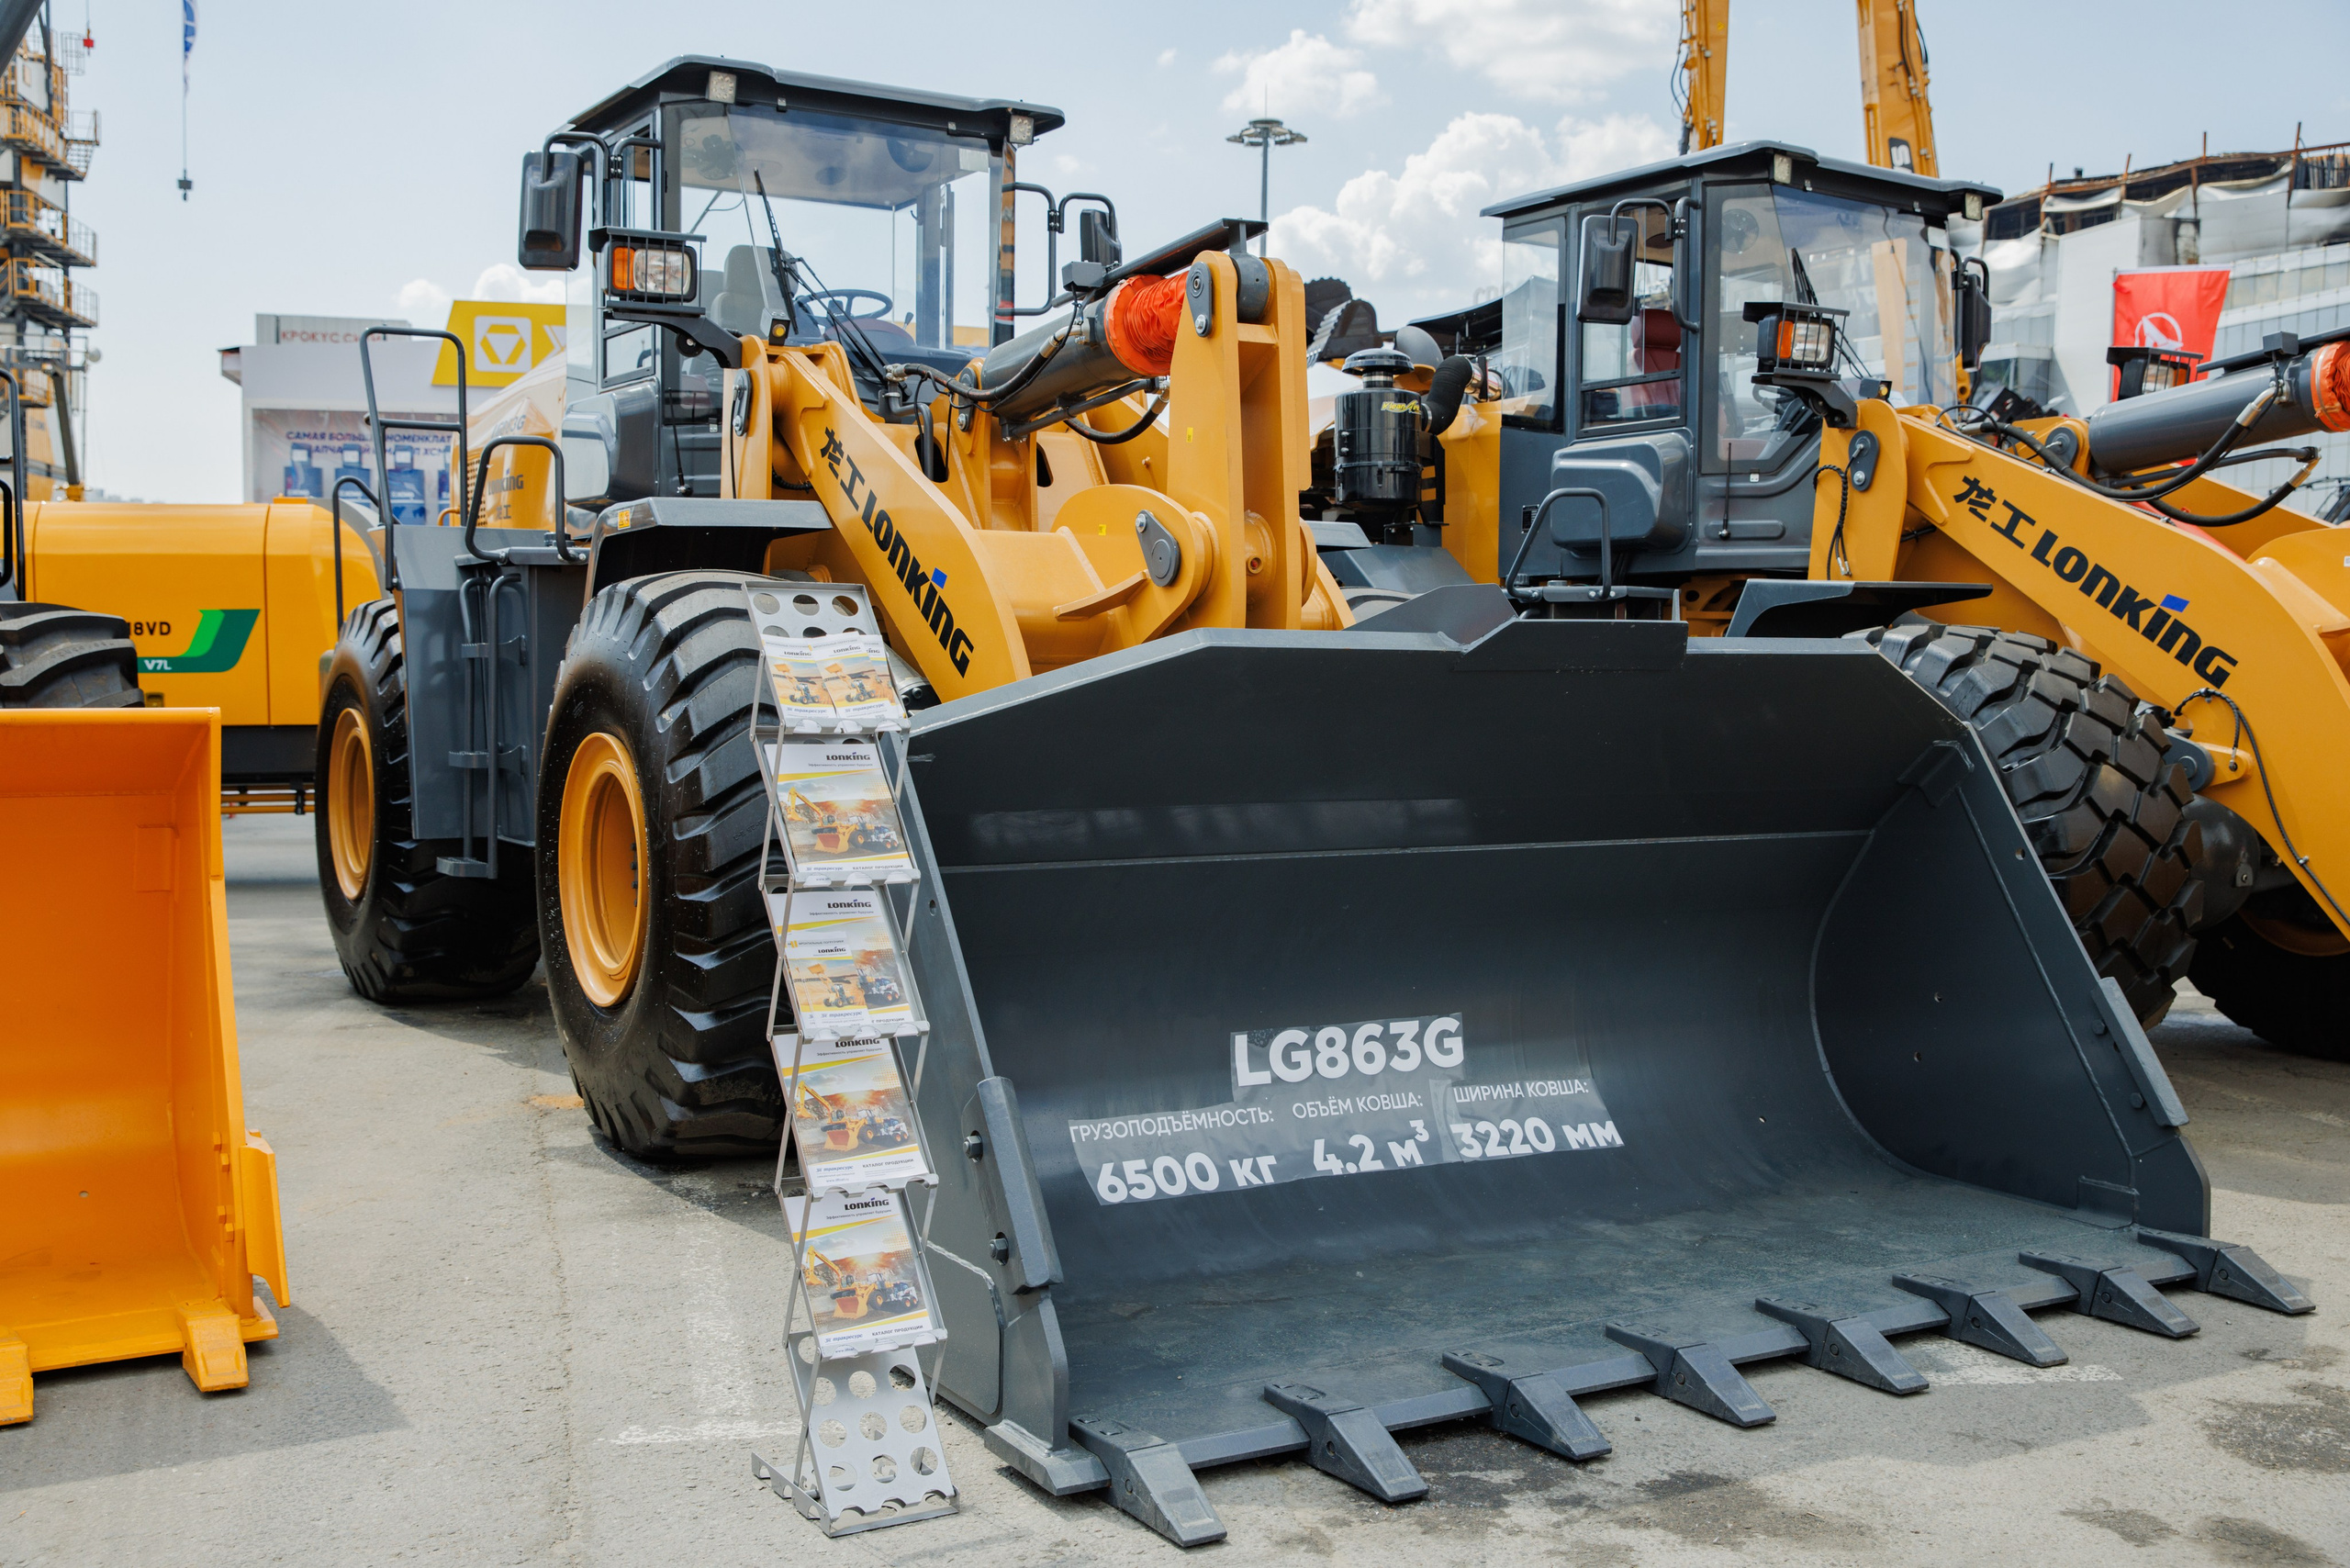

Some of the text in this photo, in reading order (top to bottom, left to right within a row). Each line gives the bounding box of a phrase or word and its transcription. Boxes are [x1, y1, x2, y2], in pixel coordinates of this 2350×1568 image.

[282, 330, 341, 343] КРОКУС
[285, 431, 326, 442] САМАЯ
[386, 432, 453, 444] НОМЕНКЛАТ
[820, 426, 866, 512] 龙工
[1953, 475, 2037, 551] 龙工
[861, 488, 975, 679] LONKING
[2030, 528, 2239, 689] LONKING
[834, 644, 861, 654] LONKING
[143, 659, 173, 670] V7L
[826, 752, 871, 761] LONKING
[827, 899, 872, 909] LONKING
[834, 1038, 880, 1048] LONKING
[1235, 1016, 1465, 1087] LG863G
[1453, 1079, 1589, 1103] ШИРИНА КОВША:
[1292, 1092, 1424, 1120] ОБЪЁМ КОВША:
[1069, 1106, 1275, 1143] ГРУЗОПОДЪЁМНОСТЬ:
[1449, 1116, 1556, 1159] 3220
[1313, 1134, 1385, 1176] 4.2
[1097, 1151, 1220, 1204] 6500
[844, 1197, 890, 1211] LONKING
[893, 1325, 923, 1333] ПРОДУКЦИИ
